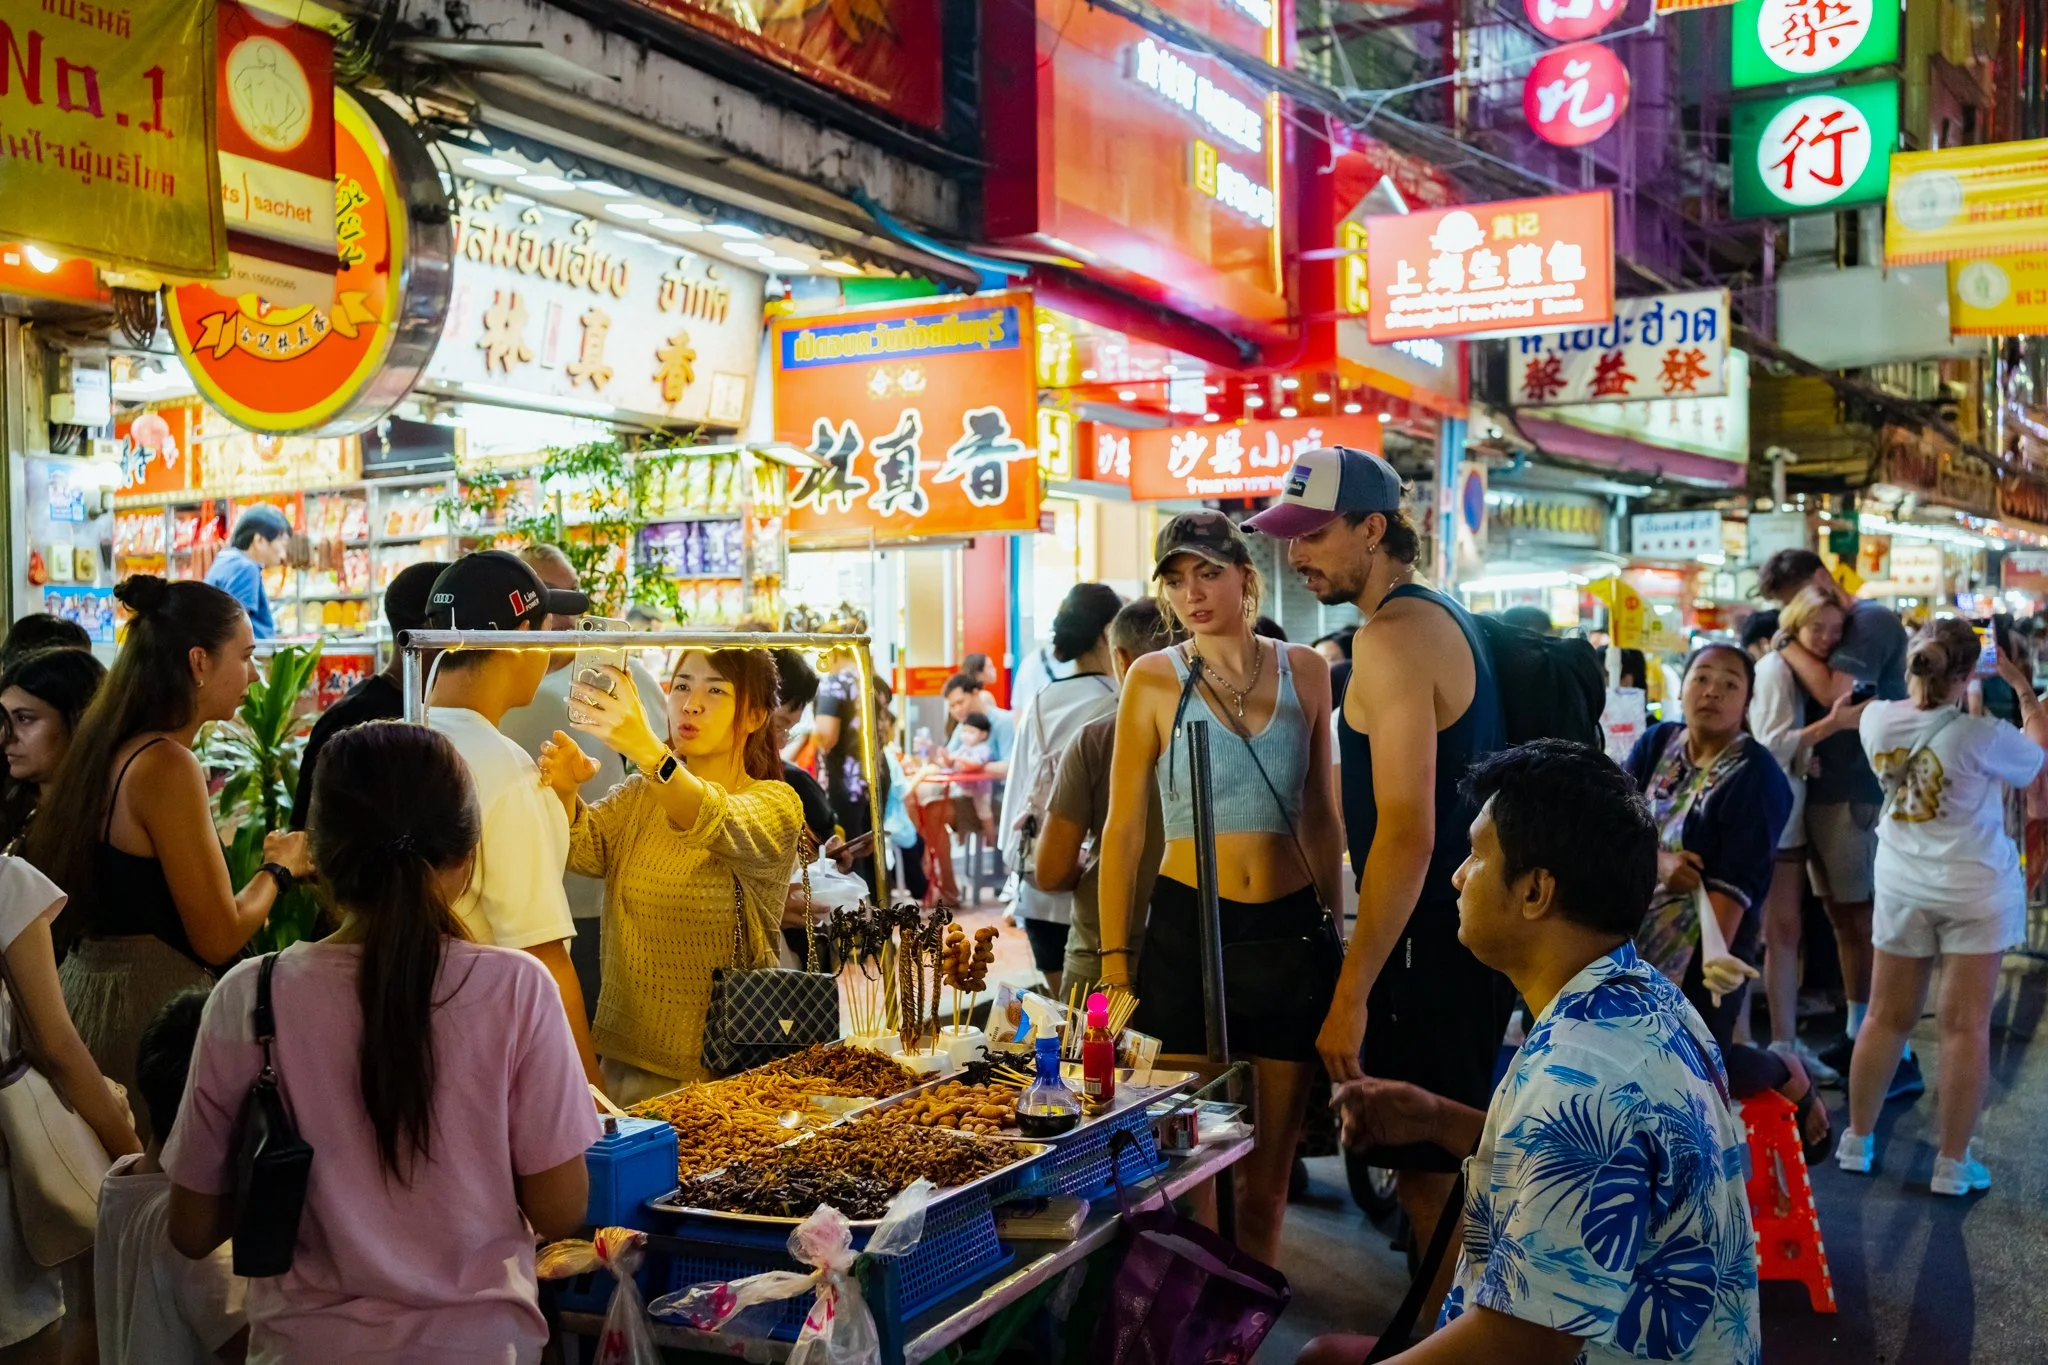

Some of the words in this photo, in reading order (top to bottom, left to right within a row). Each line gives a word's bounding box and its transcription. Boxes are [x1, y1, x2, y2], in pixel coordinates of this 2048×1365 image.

[0, 121, 175, 197] นใจผู้บริโภค
[253, 195, 313, 224] sachet
